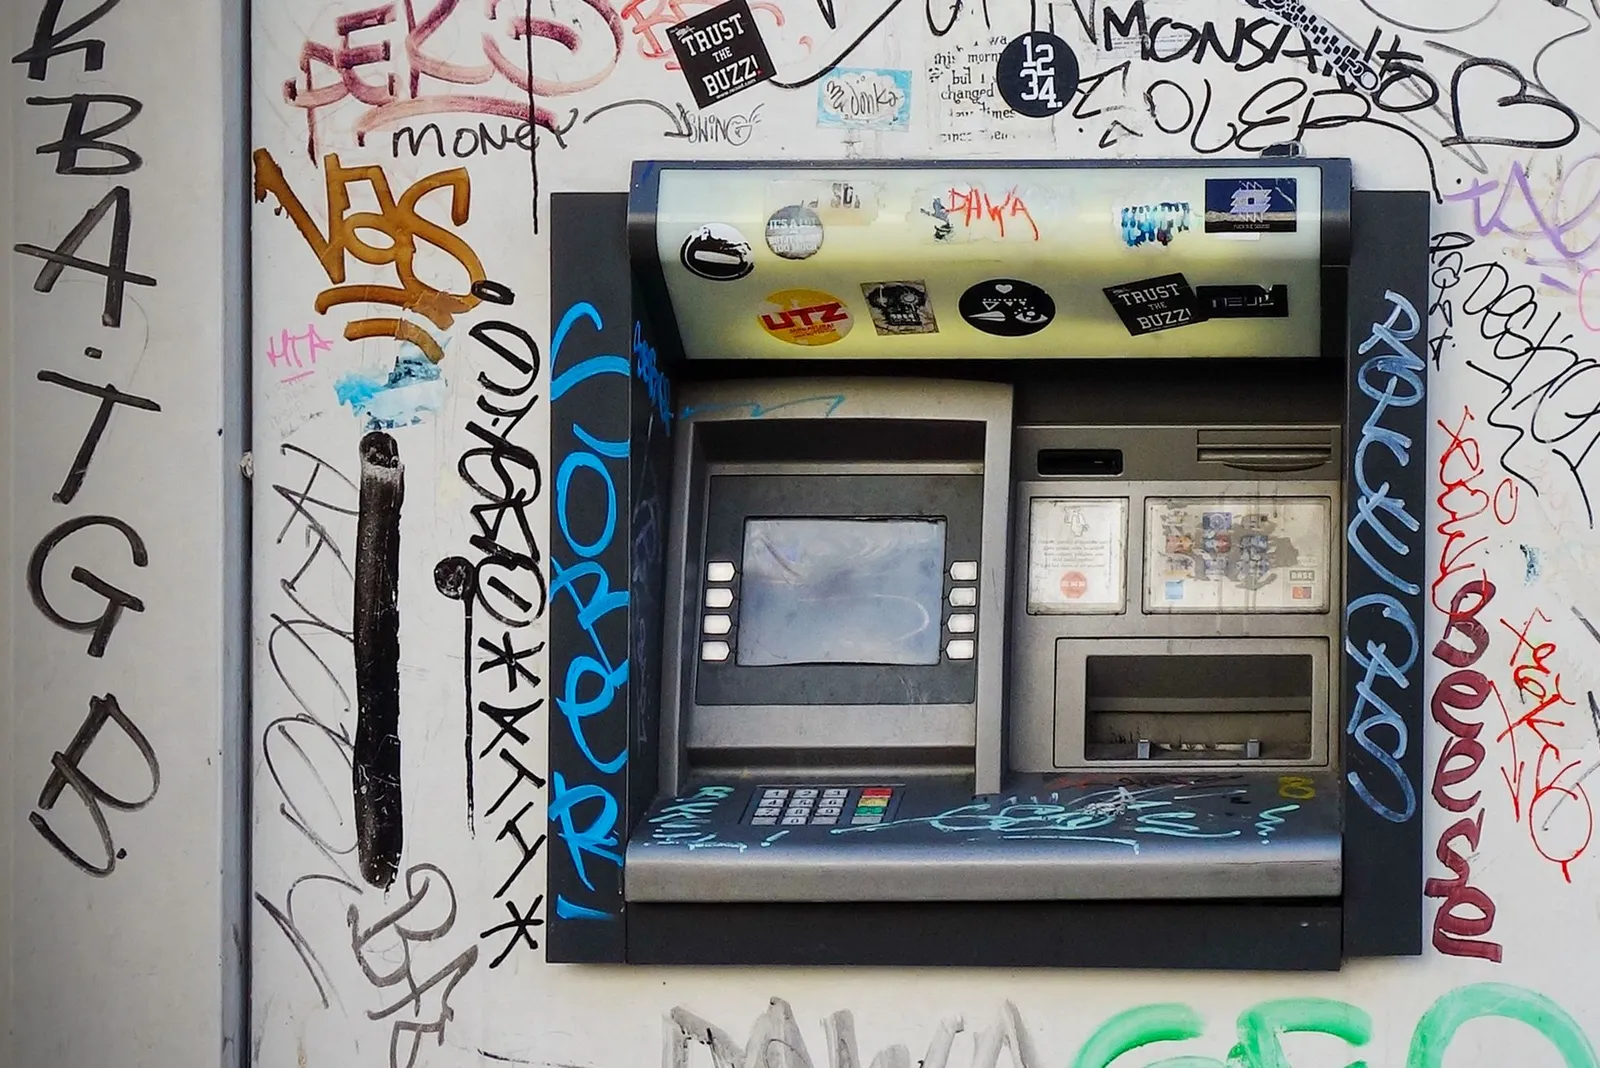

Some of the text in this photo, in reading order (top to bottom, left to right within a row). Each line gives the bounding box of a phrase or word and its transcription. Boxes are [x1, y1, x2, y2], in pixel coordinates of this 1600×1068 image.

[681, 12, 745, 57] TRUST
[712, 46, 733, 63] THE
[702, 54, 762, 97] BUZZ!
[1118, 283, 1180, 307] TRUST
[1148, 301, 1168, 311] THE
[761, 302, 849, 331] UTZ
[1136, 307, 1192, 330] BUZZ!
